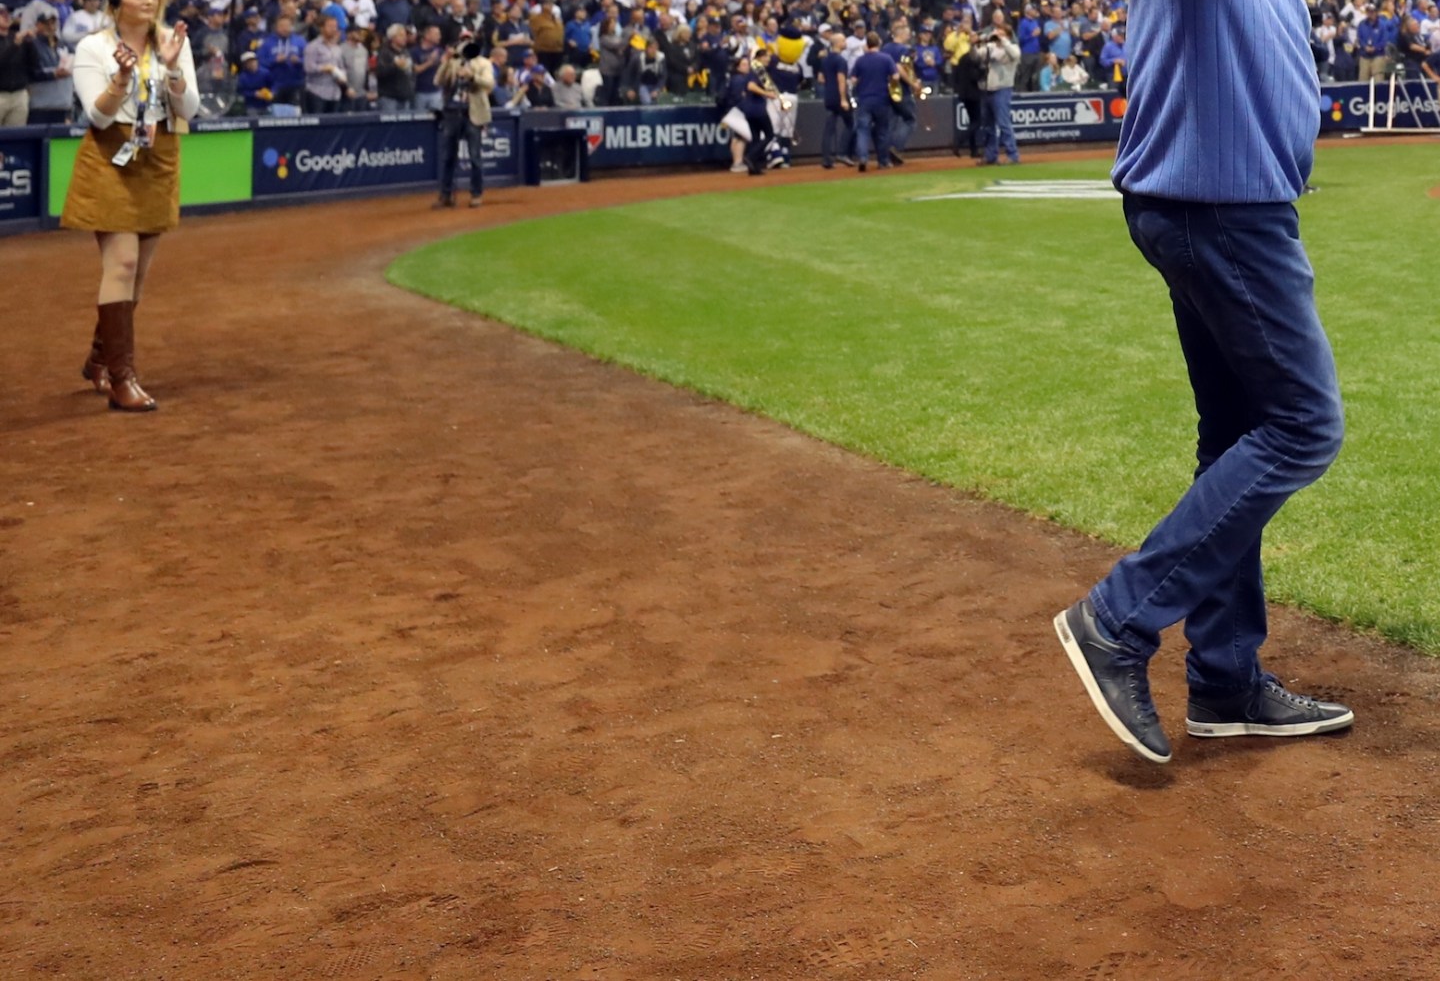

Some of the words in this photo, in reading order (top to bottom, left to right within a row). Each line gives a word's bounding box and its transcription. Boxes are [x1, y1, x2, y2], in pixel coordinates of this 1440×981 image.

[605, 124, 652, 149] MLB
[655, 123, 731, 146] NETWO
[1036, 128, 1081, 140] Experience
[296, 147, 356, 176] Google
[358, 146, 424, 168] Assistant
